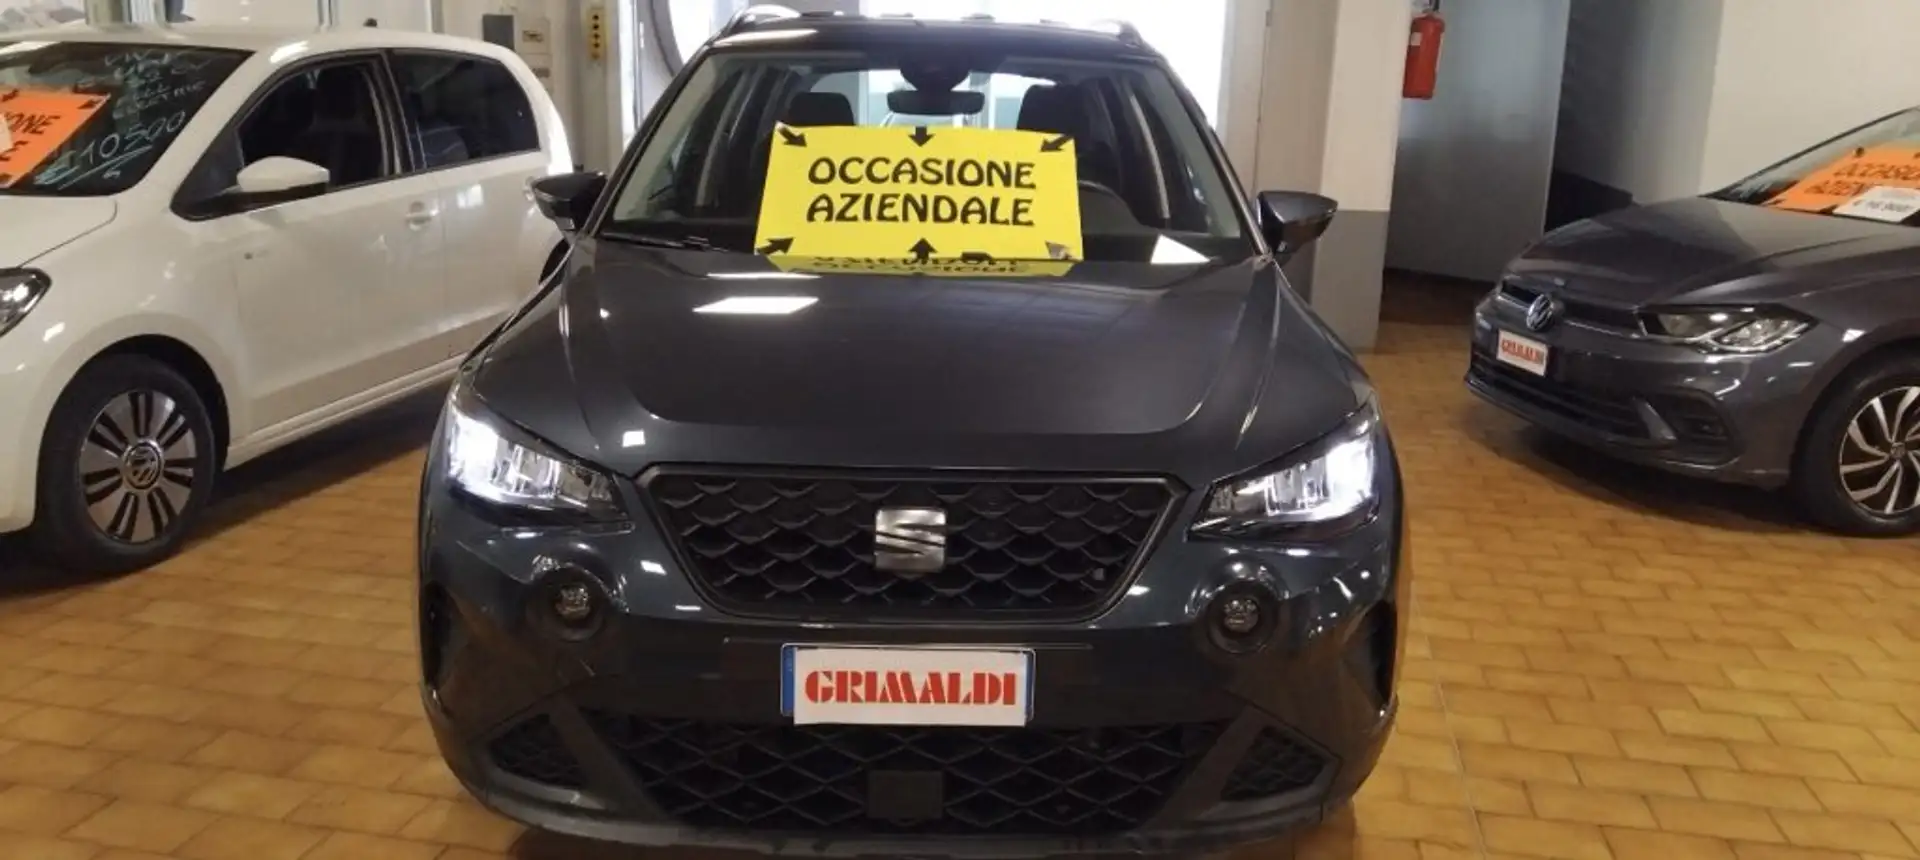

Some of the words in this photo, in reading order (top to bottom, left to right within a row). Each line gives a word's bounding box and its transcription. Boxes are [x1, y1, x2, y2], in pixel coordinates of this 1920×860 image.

[807, 156, 1037, 190] OCCASIONE
[806, 192, 1035, 227] AZIENDALE
[804, 670, 1017, 706] GRIMALDI
